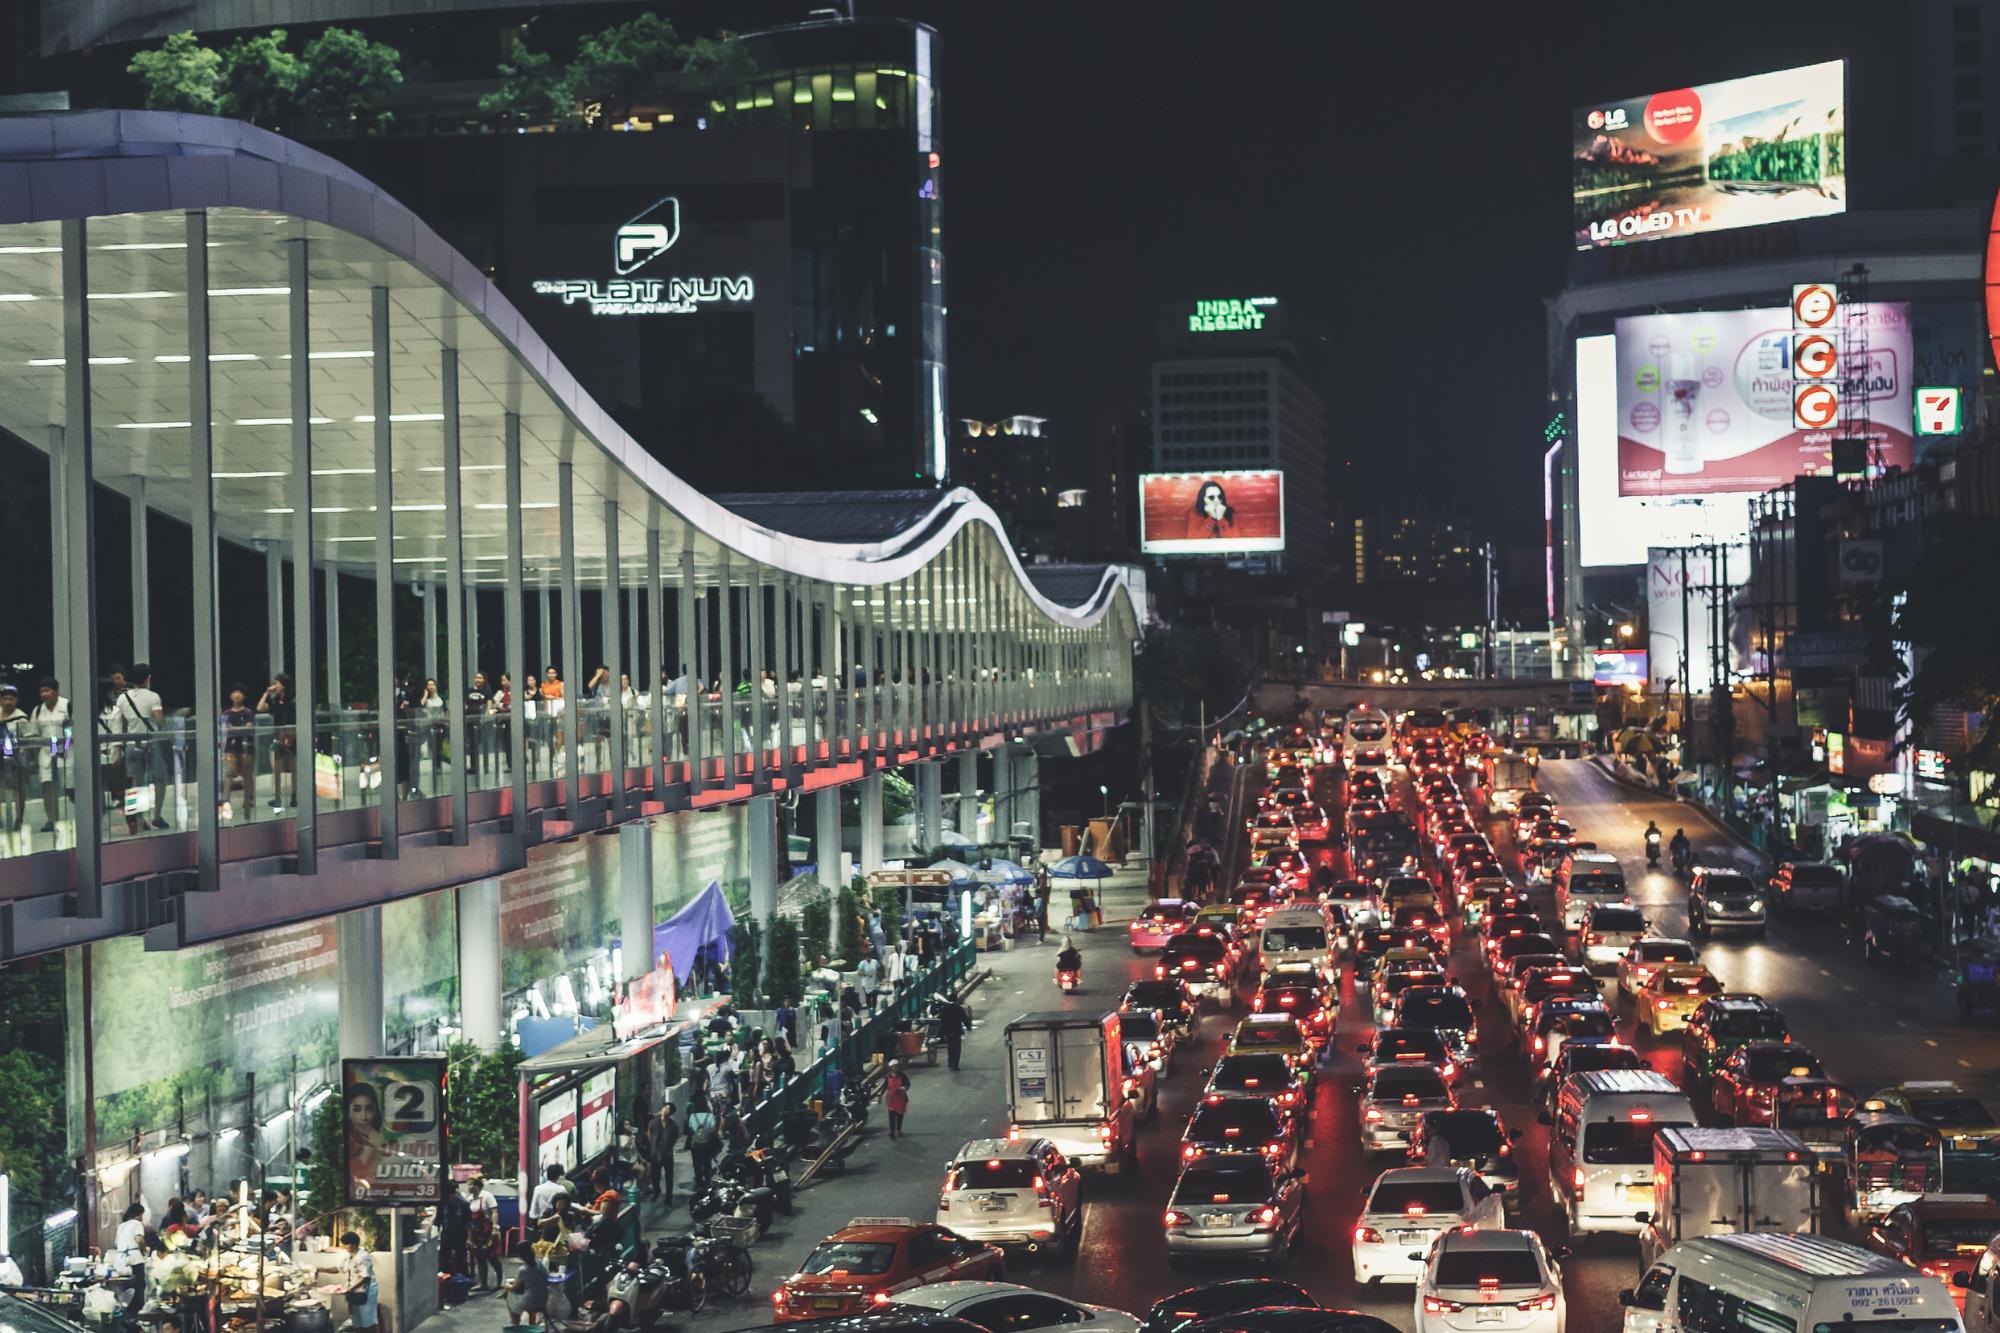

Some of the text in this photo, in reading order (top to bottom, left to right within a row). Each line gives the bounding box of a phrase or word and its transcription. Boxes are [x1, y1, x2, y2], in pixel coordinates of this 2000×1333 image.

[1604, 108, 1627, 124] LG
[1589, 207, 1702, 242] LG OLED TV
[563, 276, 755, 305] PLATNUM
[1196, 299, 1257, 317] INDRA
[1188, 312, 1266, 332] REGENT
[394, 1084, 425, 1120] 2
[415, 1184, 436, 1197] 38
